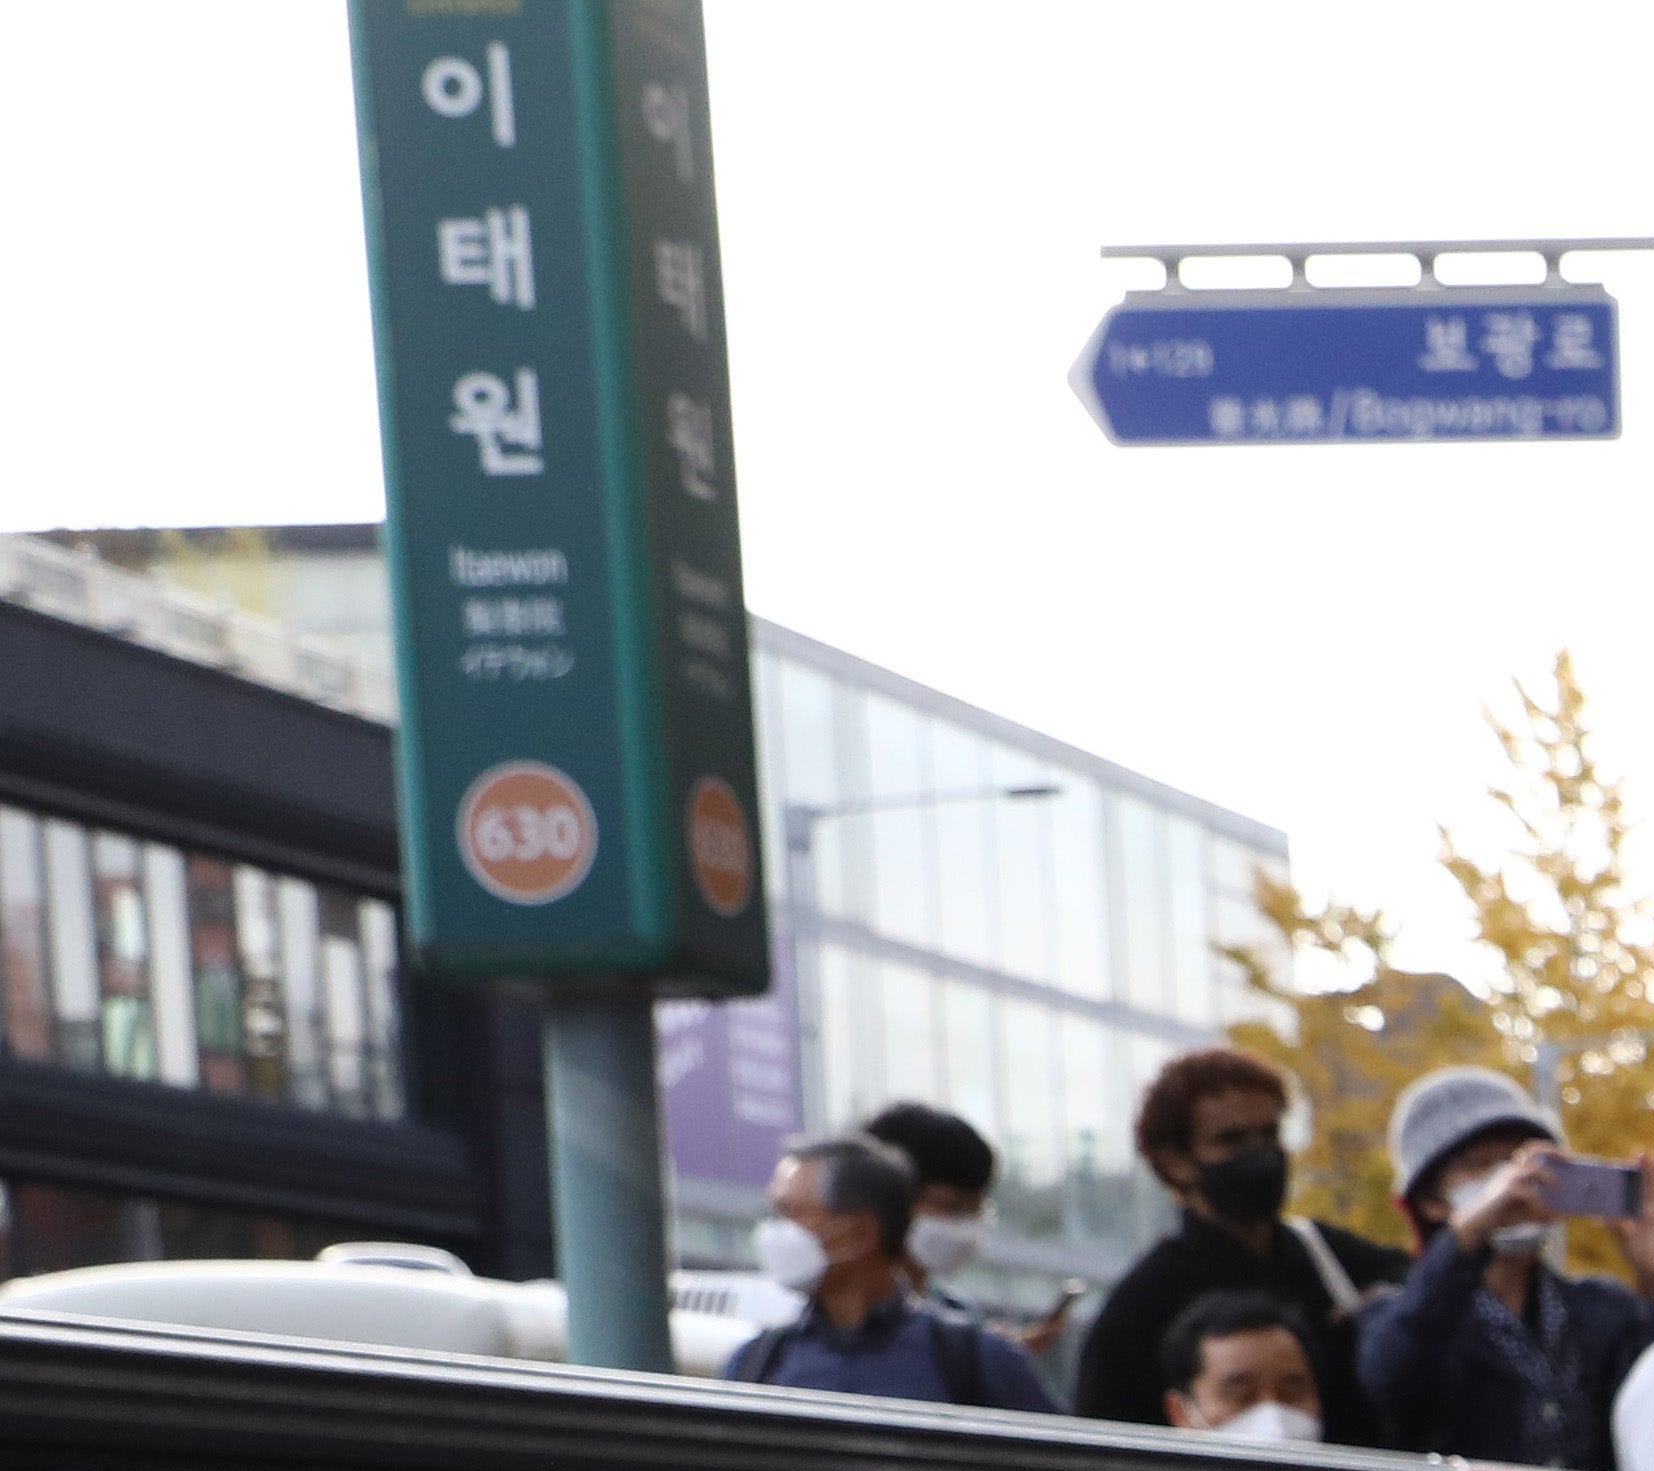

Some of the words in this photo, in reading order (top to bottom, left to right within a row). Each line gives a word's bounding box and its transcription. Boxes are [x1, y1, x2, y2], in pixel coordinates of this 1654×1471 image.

[421, 40, 545, 476] 이태원
[1418, 310, 1603, 379] 보광로
[448, 546, 569, 585] Itaewon
[472, 804, 582, 863] 630
